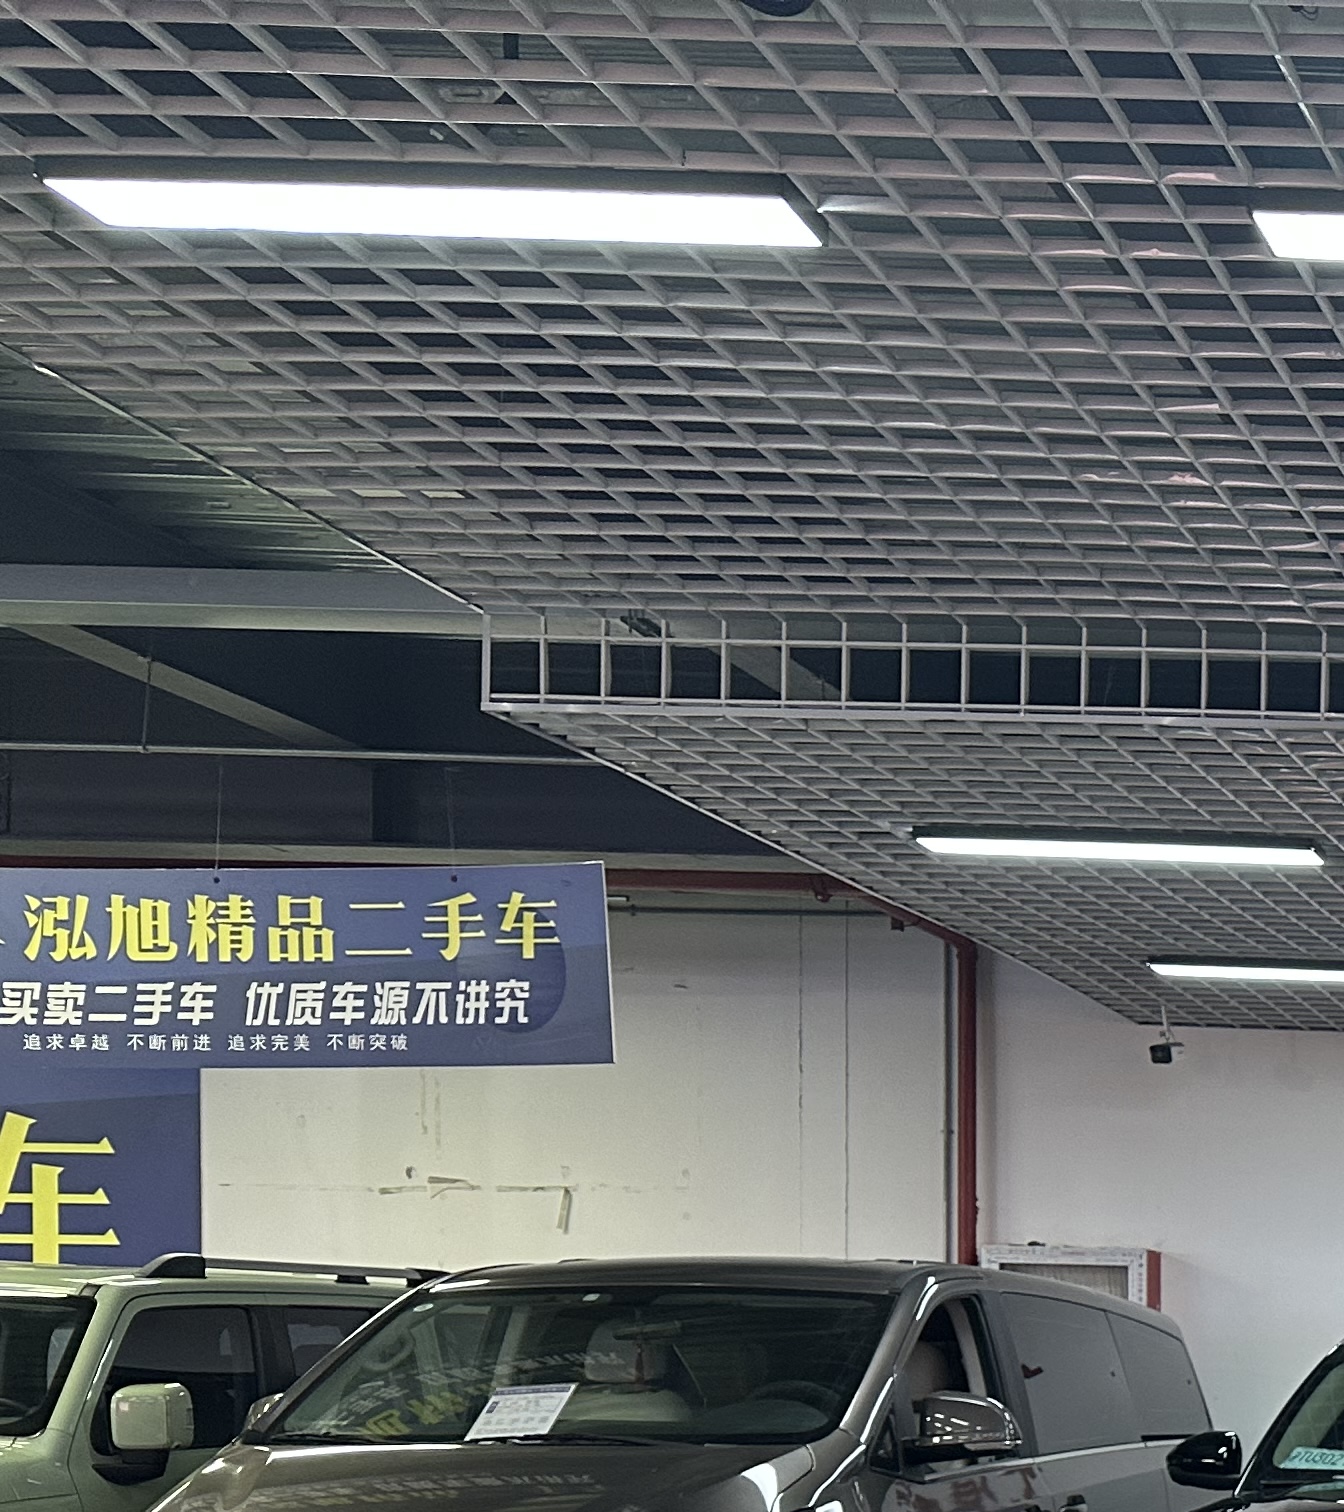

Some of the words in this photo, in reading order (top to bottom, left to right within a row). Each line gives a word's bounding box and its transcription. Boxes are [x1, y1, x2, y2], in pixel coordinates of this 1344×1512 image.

[23, 891, 560, 962] 泓旭精品二手车
[0, 981, 217, 1026] 买卖二手车
[245, 980, 529, 1026] 优质车源不讲究
[23, 1033, 110, 1051] 追求卓越
[127, 1033, 212, 1051] 不断前进
[227, 1033, 311, 1052] 追求完美
[326, 1032, 409, 1052] 不断突破
